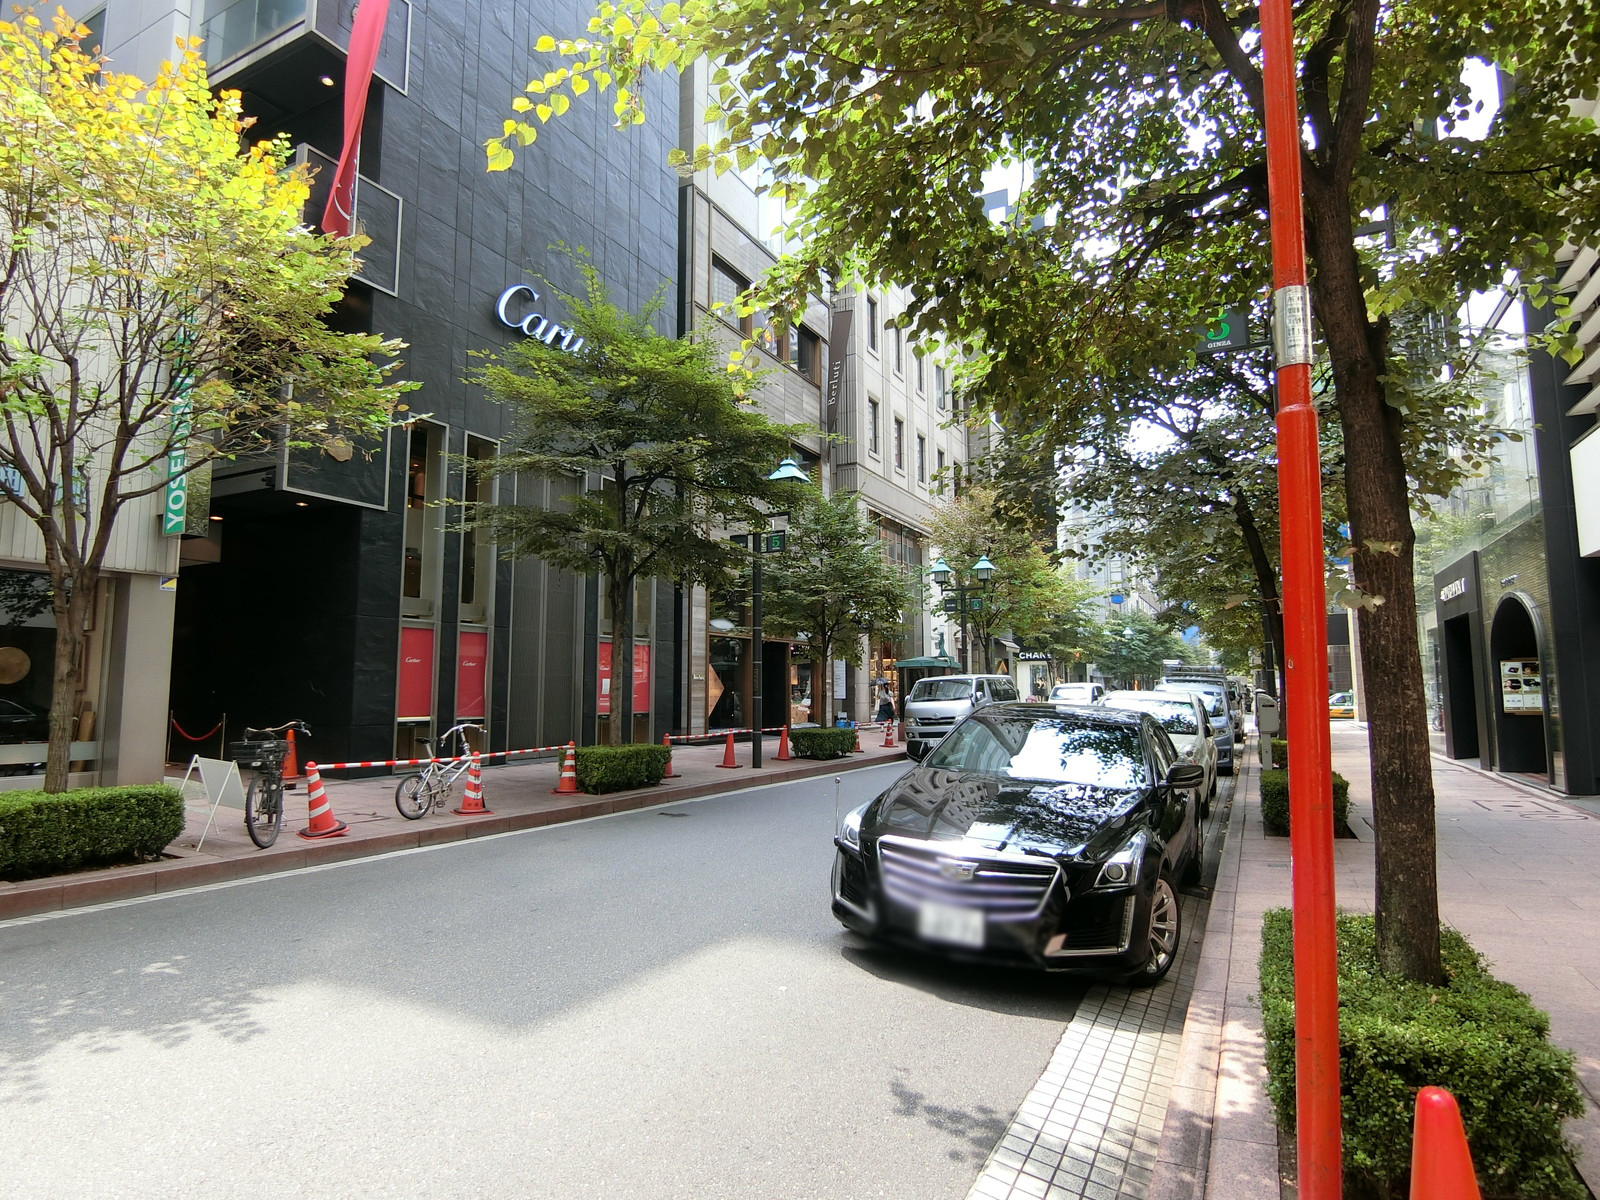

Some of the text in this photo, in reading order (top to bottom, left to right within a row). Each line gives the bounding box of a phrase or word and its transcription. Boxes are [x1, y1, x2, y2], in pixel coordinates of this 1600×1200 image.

[1207, 340, 1232, 349] GINZA
[828, 360, 841, 406] Berluti
[772, 535, 780, 547] 5
